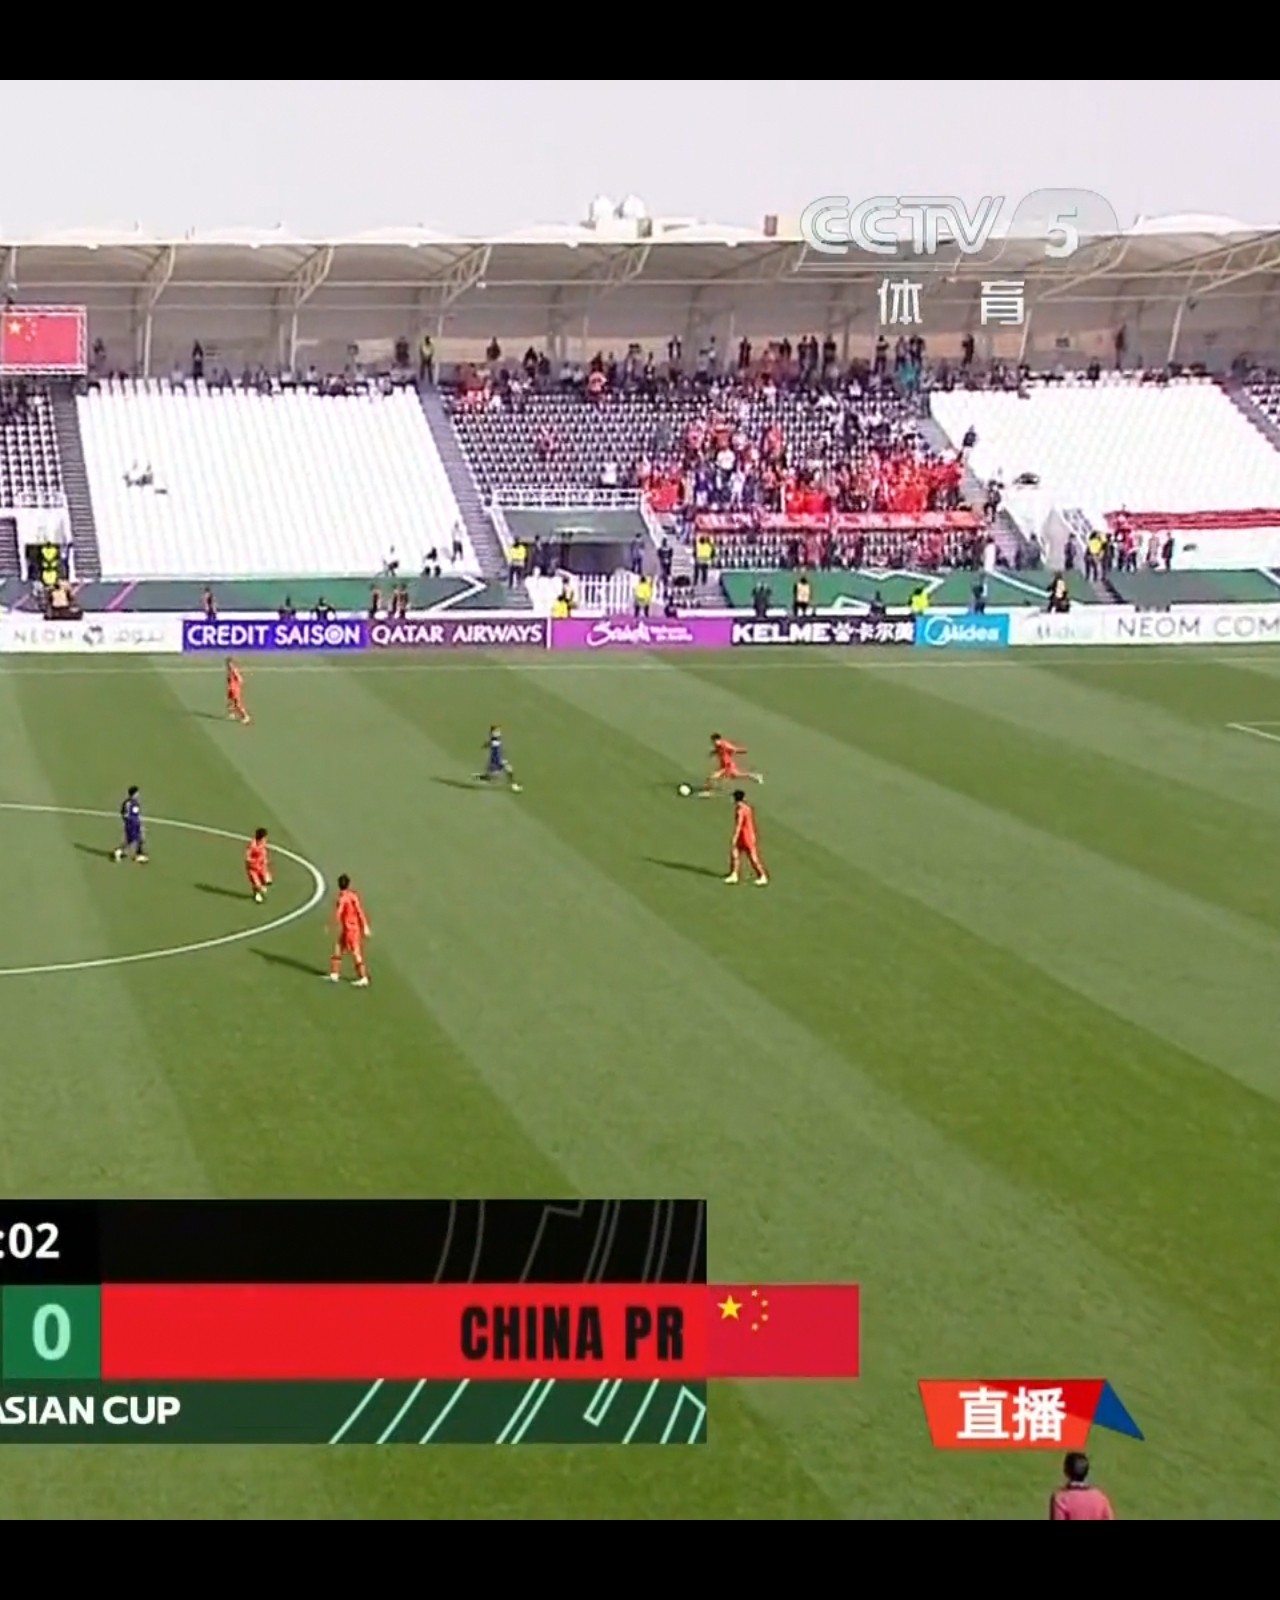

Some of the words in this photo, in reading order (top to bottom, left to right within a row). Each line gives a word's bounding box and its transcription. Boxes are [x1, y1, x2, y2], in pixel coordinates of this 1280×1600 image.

[187, 625, 271, 646] CREDIT
[274, 624, 361, 646] SAISON
[371, 624, 445, 645] QATAR
[452, 623, 543, 643] AIRWAYS
[732, 622, 831, 643] KELME
[938, 623, 1000, 641] Midea
[1117, 616, 1200, 638] NEOM
